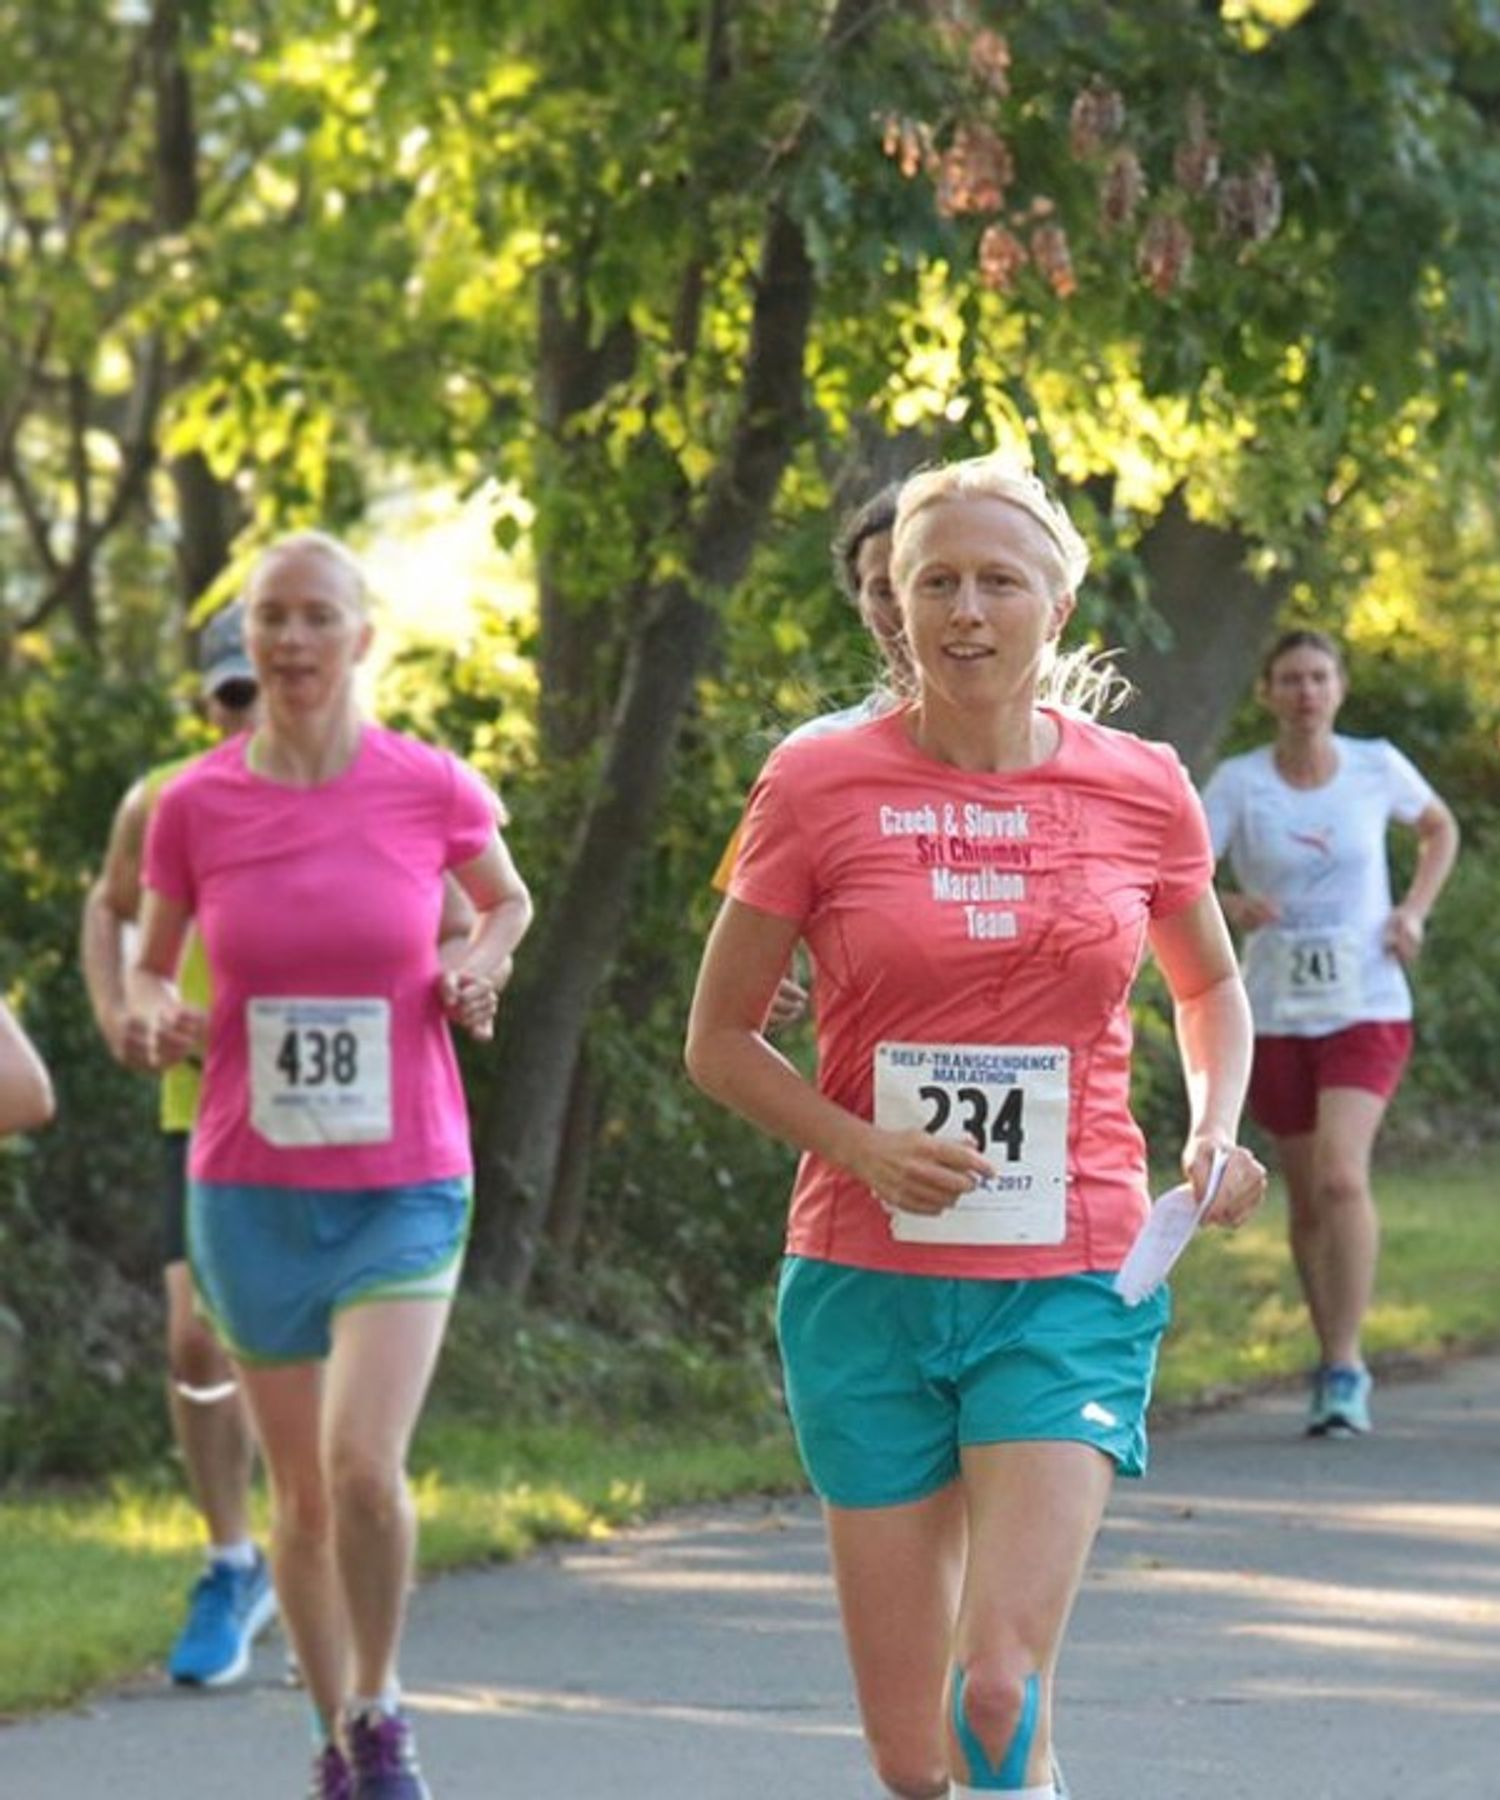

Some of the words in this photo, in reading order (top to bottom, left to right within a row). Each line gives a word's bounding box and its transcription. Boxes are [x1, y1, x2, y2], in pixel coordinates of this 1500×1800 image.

[880, 804, 938, 836] Czech
[943, 803, 959, 837] &
[964, 803, 1029, 839] Slovak
[917, 837, 945, 864] Sri
[932, 867, 1026, 901] Marathon
[964, 906, 1017, 939] Team
[275, 1030, 357, 1086] 438
[890, 1050, 1057, 1071] SELF-TRANSCENDENCE
[932, 1068, 1017, 1083] MARATHON
[918, 1085, 1025, 1162] 234
[997, 1174, 1032, 1191] 2017
